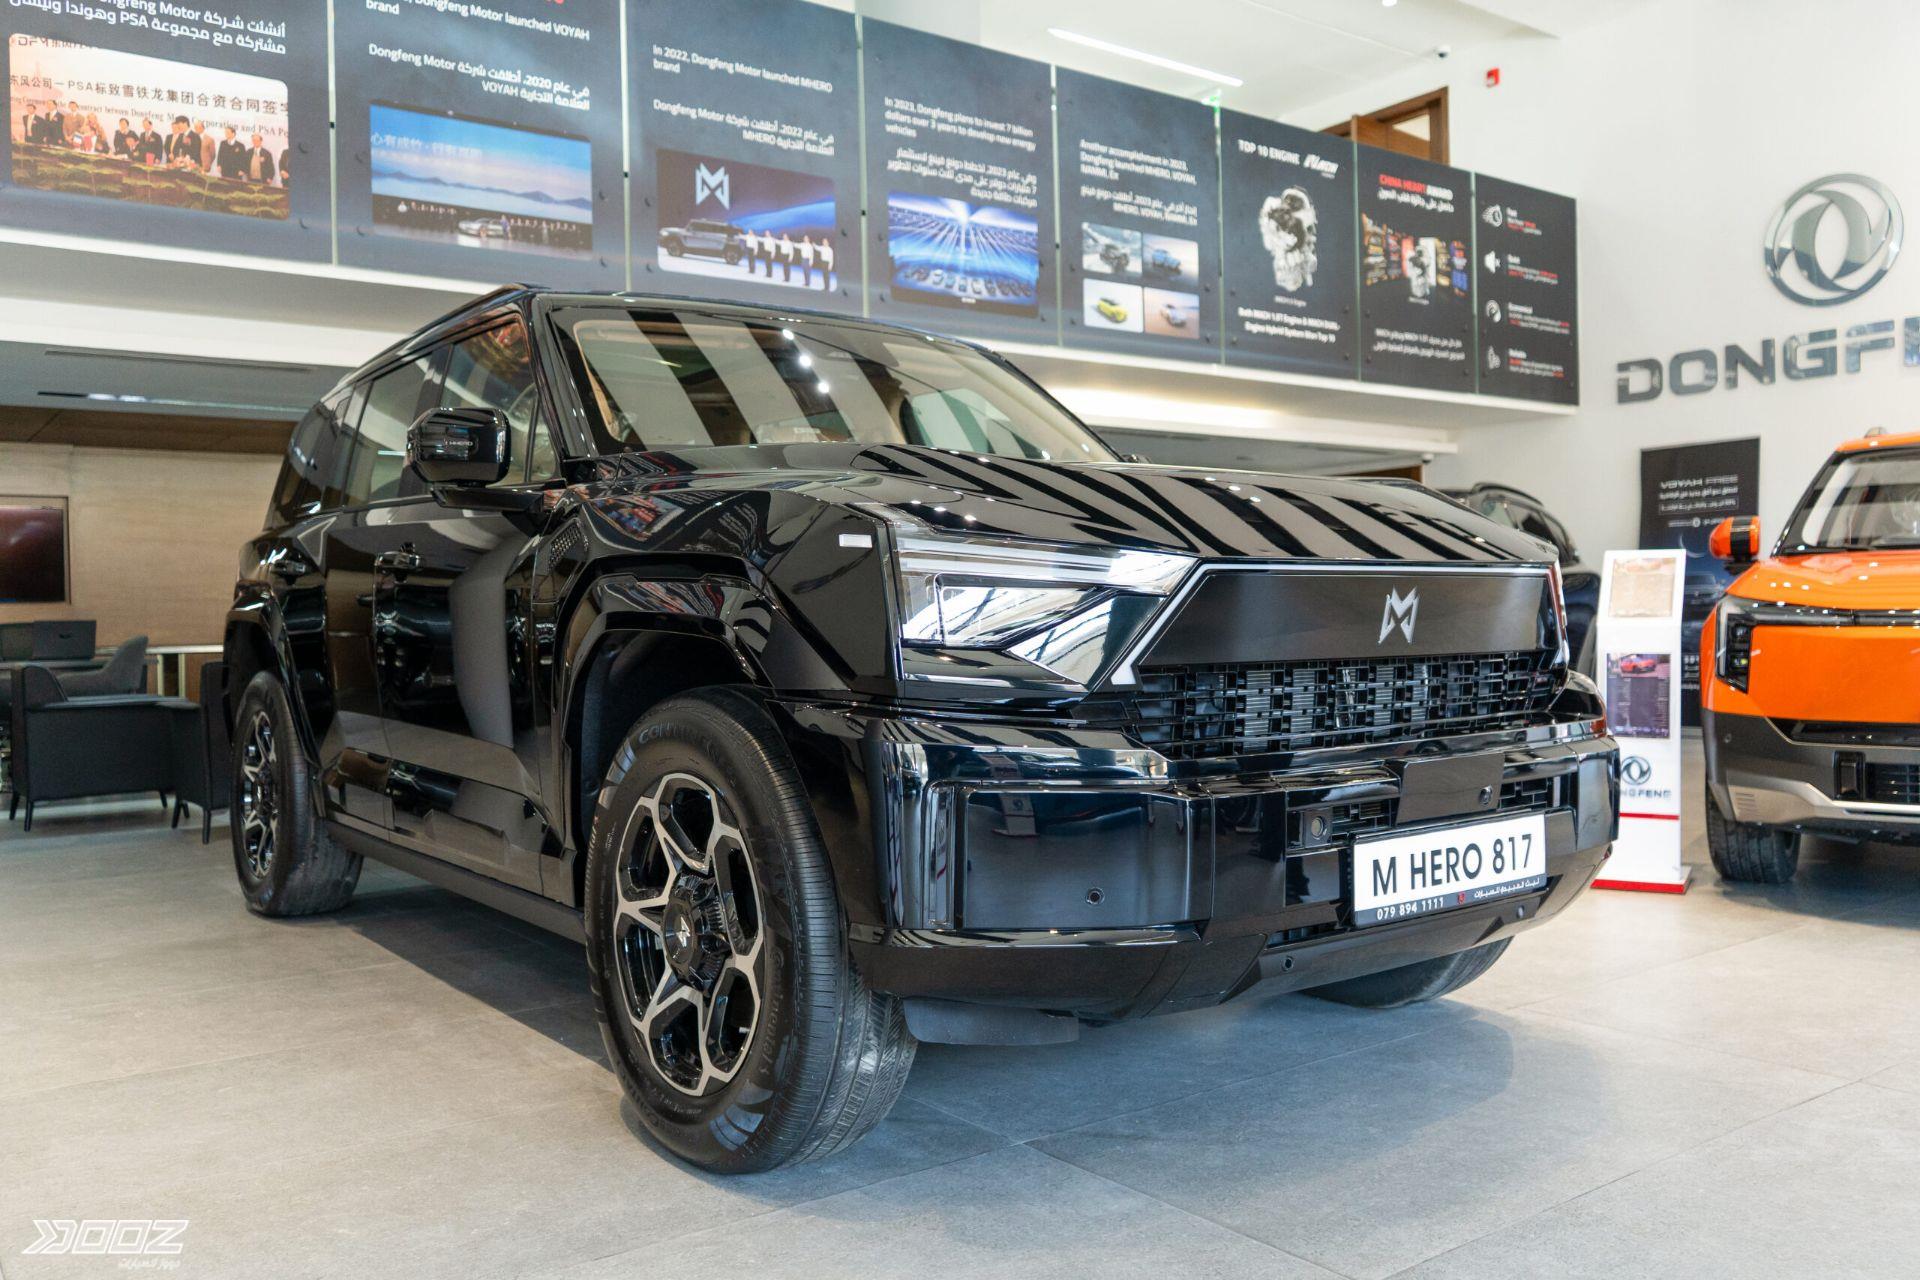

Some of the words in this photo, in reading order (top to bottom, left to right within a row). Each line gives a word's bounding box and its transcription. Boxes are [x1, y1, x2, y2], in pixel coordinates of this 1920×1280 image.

[120, 11, 149, 28] PSA
[159, 1, 201, 21] Motor
[366, 0, 400, 15] brand
[151, 18, 209, 43] مجموعة
[203, 12, 244, 32] شركة
[470, 4, 503, 21] Motor
[506, 12, 551, 33] launched
[552, 18, 590, 40] VOYAH
[213, 31, 233, 47] مع
[236, 32, 286, 54] مشتركة
[368, 43, 422, 66] Dongfeng
[424, 54, 457, 72] Motor
[691, 53, 734, 74] Dongfeng
[735, 62, 761, 78] Motor
[482, 80, 519, 98] VOYAH
[653, 99, 697, 119] Dongfeng
[698, 108, 724, 123] Motor
[1238, 139, 1256, 153] TOP
[1257, 145, 1268, 157] 10
[1269, 147, 1300, 165] ENGINE
[1372, 856, 1398, 897] M
[1410, 842, 1482, 890] HERO
[1492, 833, 1532, 874] 817
[1376, 904, 1396, 921] 079
[1399, 901, 1418, 918] 894
[1421, 897, 1444, 914] 1111
